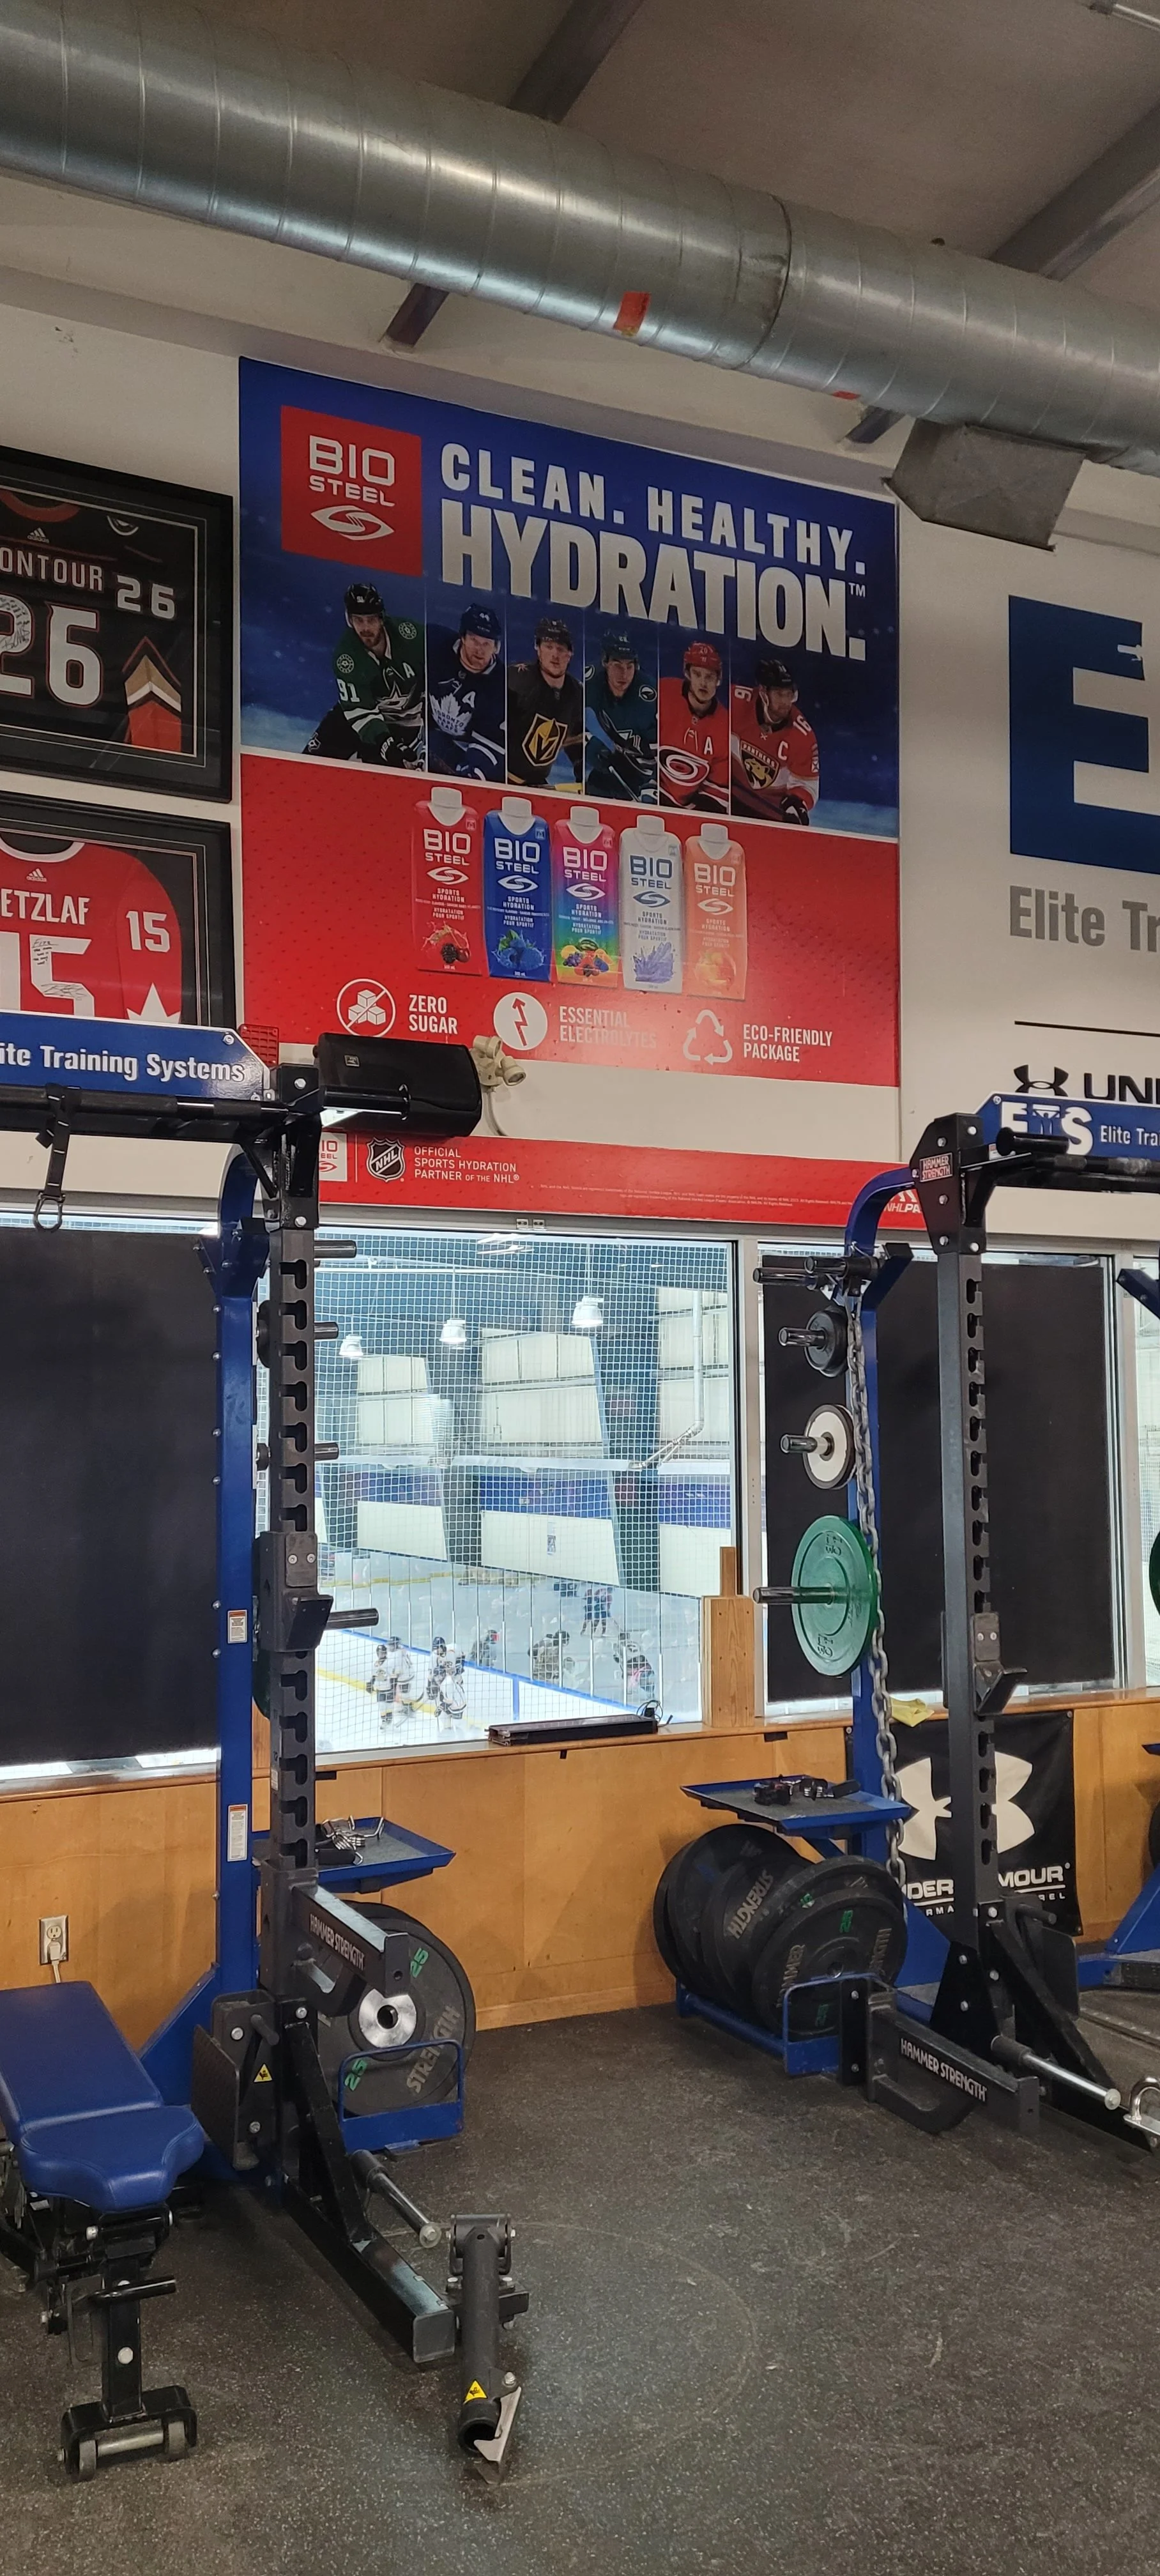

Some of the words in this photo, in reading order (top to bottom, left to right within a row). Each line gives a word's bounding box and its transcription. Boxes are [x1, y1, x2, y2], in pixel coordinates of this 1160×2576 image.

[309, 435, 395, 486] BIO
[309, 475, 395, 507] STEEL
[441, 443, 624, 525] CLEAN.
[648, 486, 866, 575] HEALTHY.
[441, 498, 866, 661] HYDRATION.
[115, 575, 176, 620] 26
[0, 594, 102, 706] 26
[402, 662, 415, 678] A
[336, 678, 360, 702] 91
[793, 714, 812, 735] 16
[704, 736, 713, 755] A
[742, 743, 775, 767] PANTHERS
[777, 740, 789, 761] C
[424, 829, 471, 854] BIO
[494, 837, 540, 862] BIO
[425, 852, 470, 866] STEEL
[496, 861, 540, 874] STEEL
[563, 846, 607, 871] BIO
[630, 855, 673, 878] BIO
[564, 869, 607, 882] STEEL
[630, 877, 672, 889] STEEL
[694, 862, 735, 886] BIO
[432, 893, 464, 903] HYDRATION
[437, 887, 460, 896] SPORTS
[507, 896, 530, 904] SPORTS
[695, 884, 735, 897] STEEL
[1, 888, 90, 925] ETZLAF
[503, 901, 535, 910] HYDRATION
[571, 909, 602, 918] HYDRATION
[576, 903, 597, 912] SPORTS
[1009, 885, 1105, 946] Elite
[126, 910, 171, 953] 15
[637, 917, 667, 925] HYDRATION
[409, 994, 447, 1015] ZERO
[409, 1014, 457, 1035] SUGAR
[560, 1006, 630, 1029] ESSENTIAL
[560, 1025, 657, 1049] ELECTROLYTES
[743, 1023, 832, 1047] ECO-FRIENDLY
[744, 1042, 800, 1062] PACKAGE
[40, 1045, 138, 1081] Training
[146, 1053, 245, 1082] Systems
[1083, 1073, 1160, 1105] UN
[1100, 1124, 1131, 1144] Elite
[1136, 1128, 1160, 1146] Tra
[375, 1150, 398, 1171] NHL
[414, 1146, 461, 1158] OFFICIAL
[922, 1155, 949, 1170] HAMMER
[415, 1158, 455, 1169] SPORTS
[459, 1160, 516, 1172] HYDRATION
[415, 1169, 462, 1181] PARTNER
[922, 1165, 950, 1180] STRENGTH
[885, 1202, 920, 1213] NHLPA
[727, 1869, 774, 1940] STRENGTH
[310, 1913, 334, 1948] HAMMER
[335, 1933, 365, 1971] STRENGTH
[410, 1947, 429, 1978] 25
[344, 2059, 368, 2091] 25
[901, 2038, 939, 2075] HAMMER
[940, 2062, 987, 2102] STRENGTH
